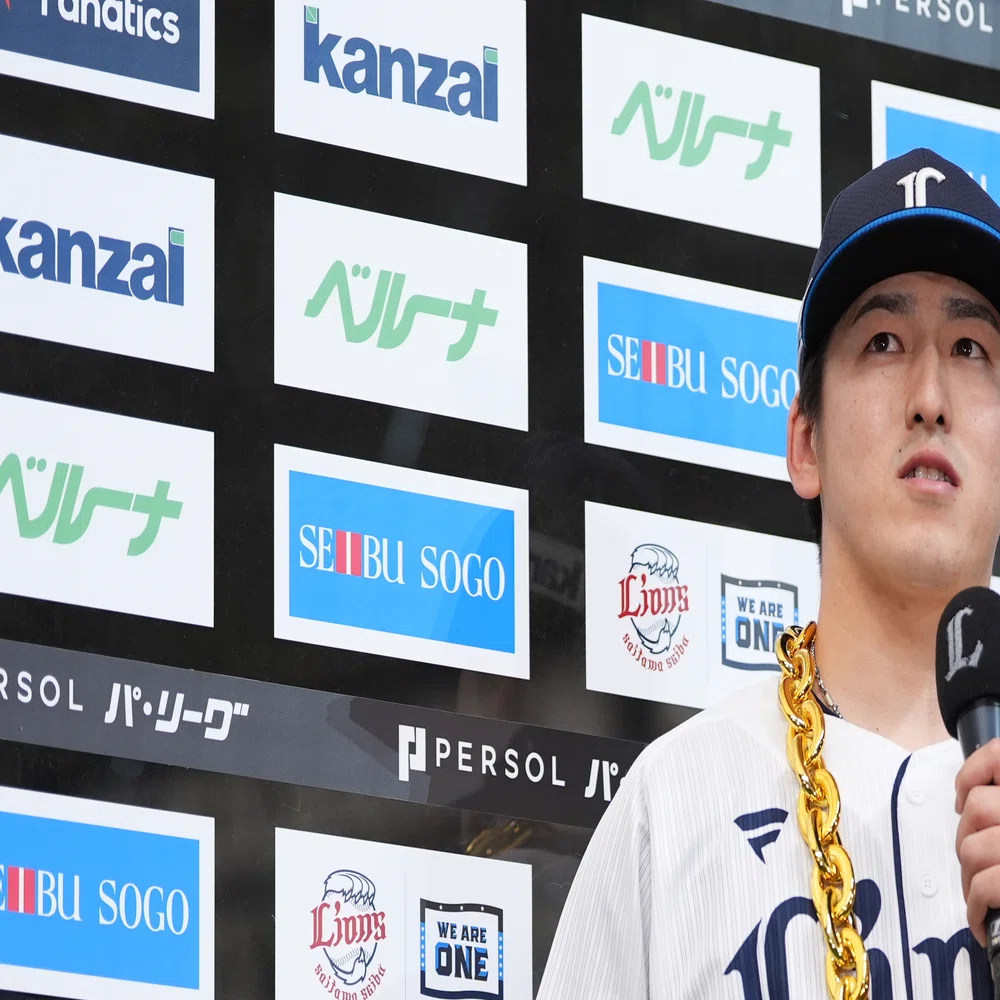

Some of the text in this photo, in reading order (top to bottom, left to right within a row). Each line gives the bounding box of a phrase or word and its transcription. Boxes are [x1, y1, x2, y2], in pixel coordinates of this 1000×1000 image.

[876, 0, 993, 33] RSOL
[304, 6, 498, 122] kanzai
[611, 80, 792, 180] ベルーナ
[304, 260, 499, 362] ベルーナ
[607, 334, 799, 411] SEIBU SOGO
[0, 452, 183, 557] ベルーナ
[299, 524, 405, 585] SEIBU
[420, 545, 505, 601] SOGO
[618, 573, 690, 619] Lions
[737, 596, 783, 618] WE ARE
[945, 605, 984, 682] L
[435, 737, 566, 787] PERSOL
[99, 879, 190, 935] SOGO
[309, 901, 387, 950] Lions
[437, 921, 487, 944] WE ARE
[435, 942, 489, 981] ONE
